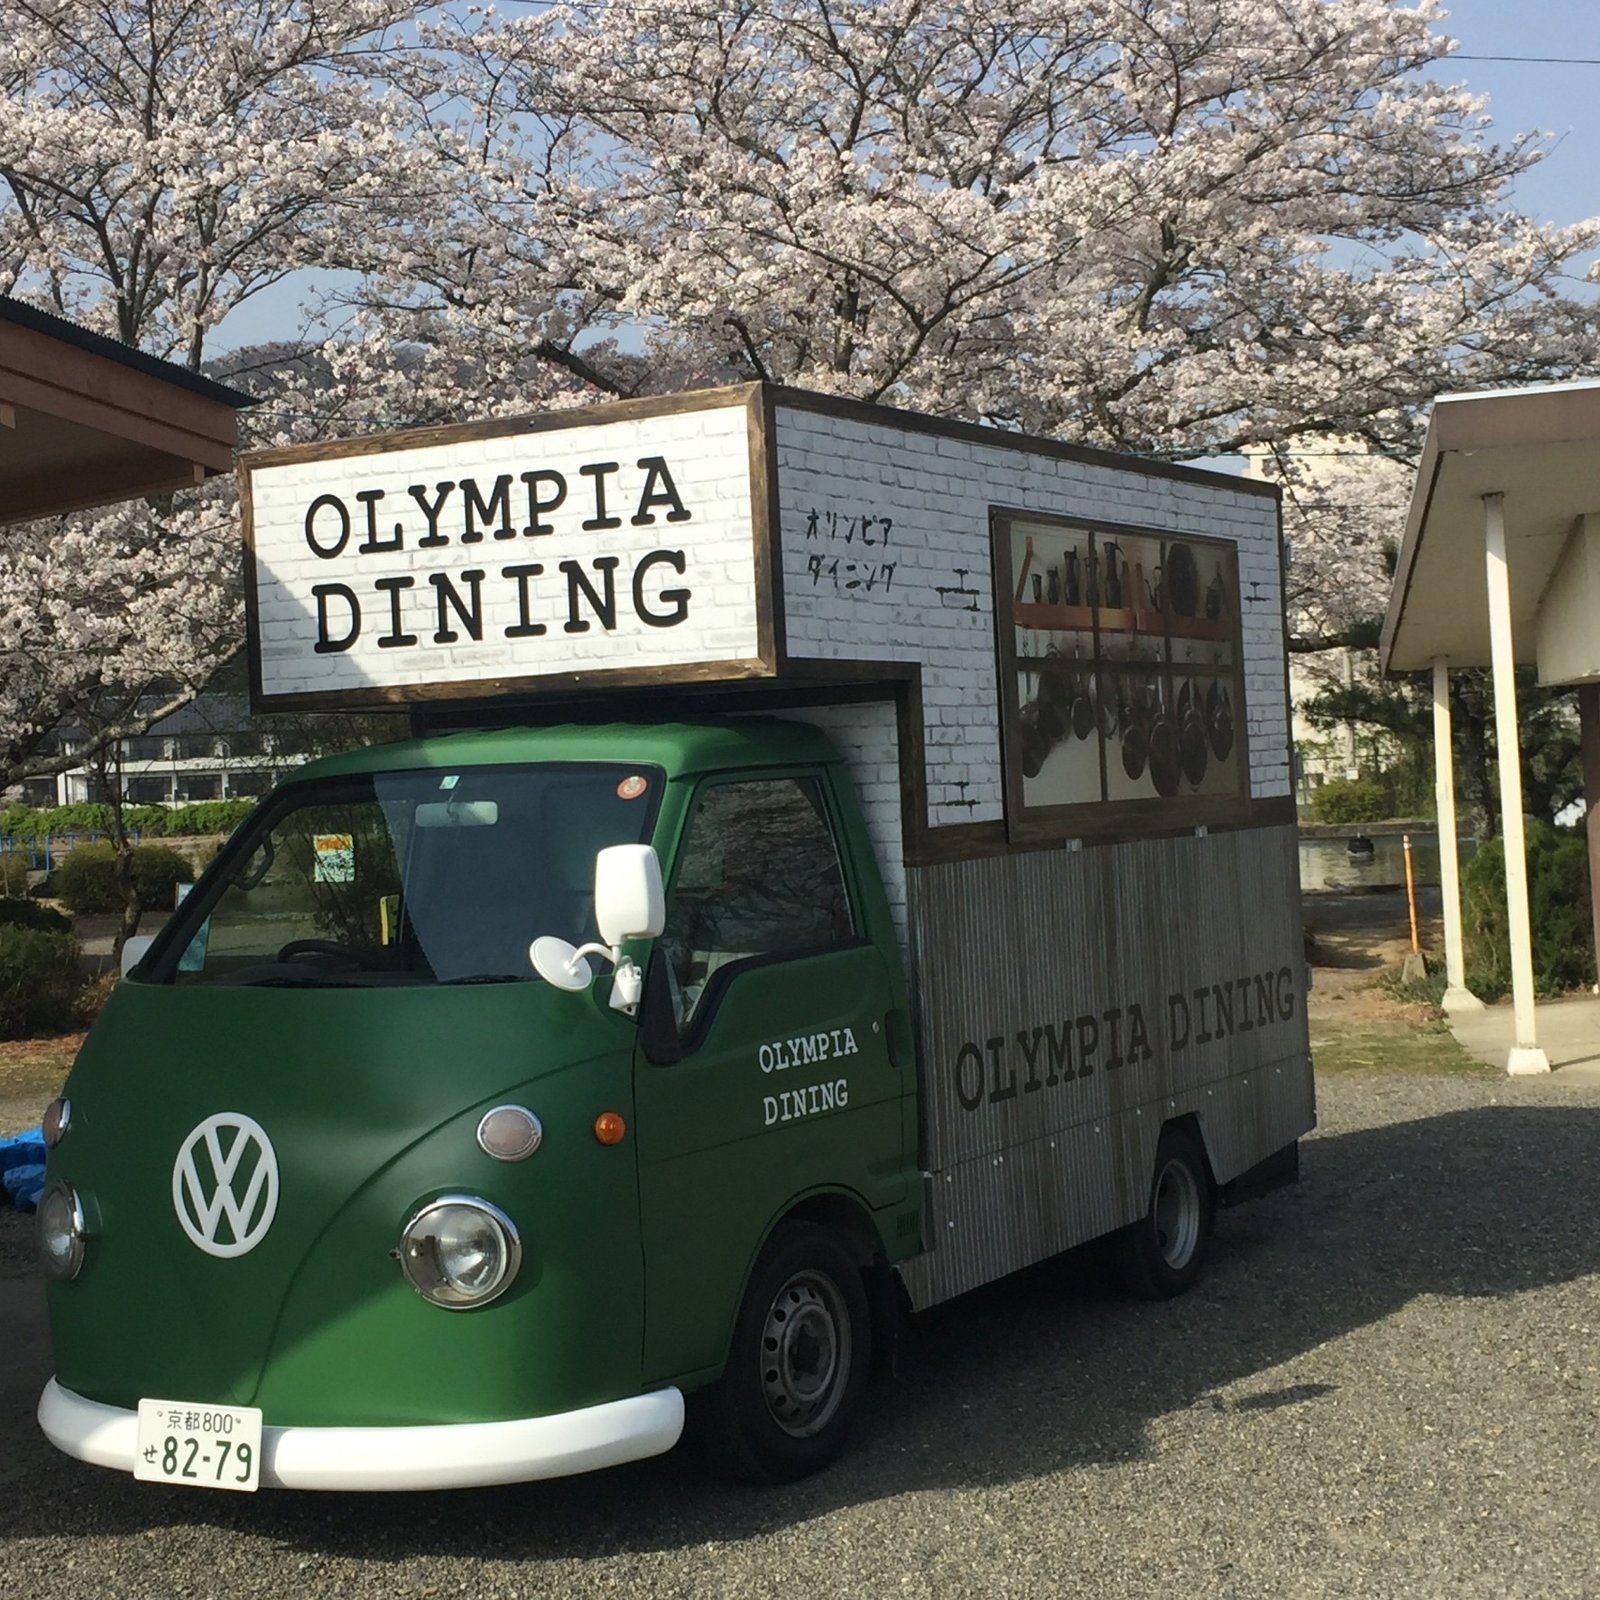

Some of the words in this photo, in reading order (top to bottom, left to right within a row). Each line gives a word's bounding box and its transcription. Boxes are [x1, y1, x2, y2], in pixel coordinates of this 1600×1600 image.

[305, 456, 692, 560] OLYMPIA
[808, 554, 897, 593] ダイニング
[312, 549, 692, 654] DINING
[759, 1028, 859, 1073] OLYMPIA
[955, 1003, 1152, 1111] OLYMPIA
[1168, 966, 1295, 1052] DINING
[763, 1079, 848, 1126] DINING
[162, 1436, 252, 1483] 82-79
